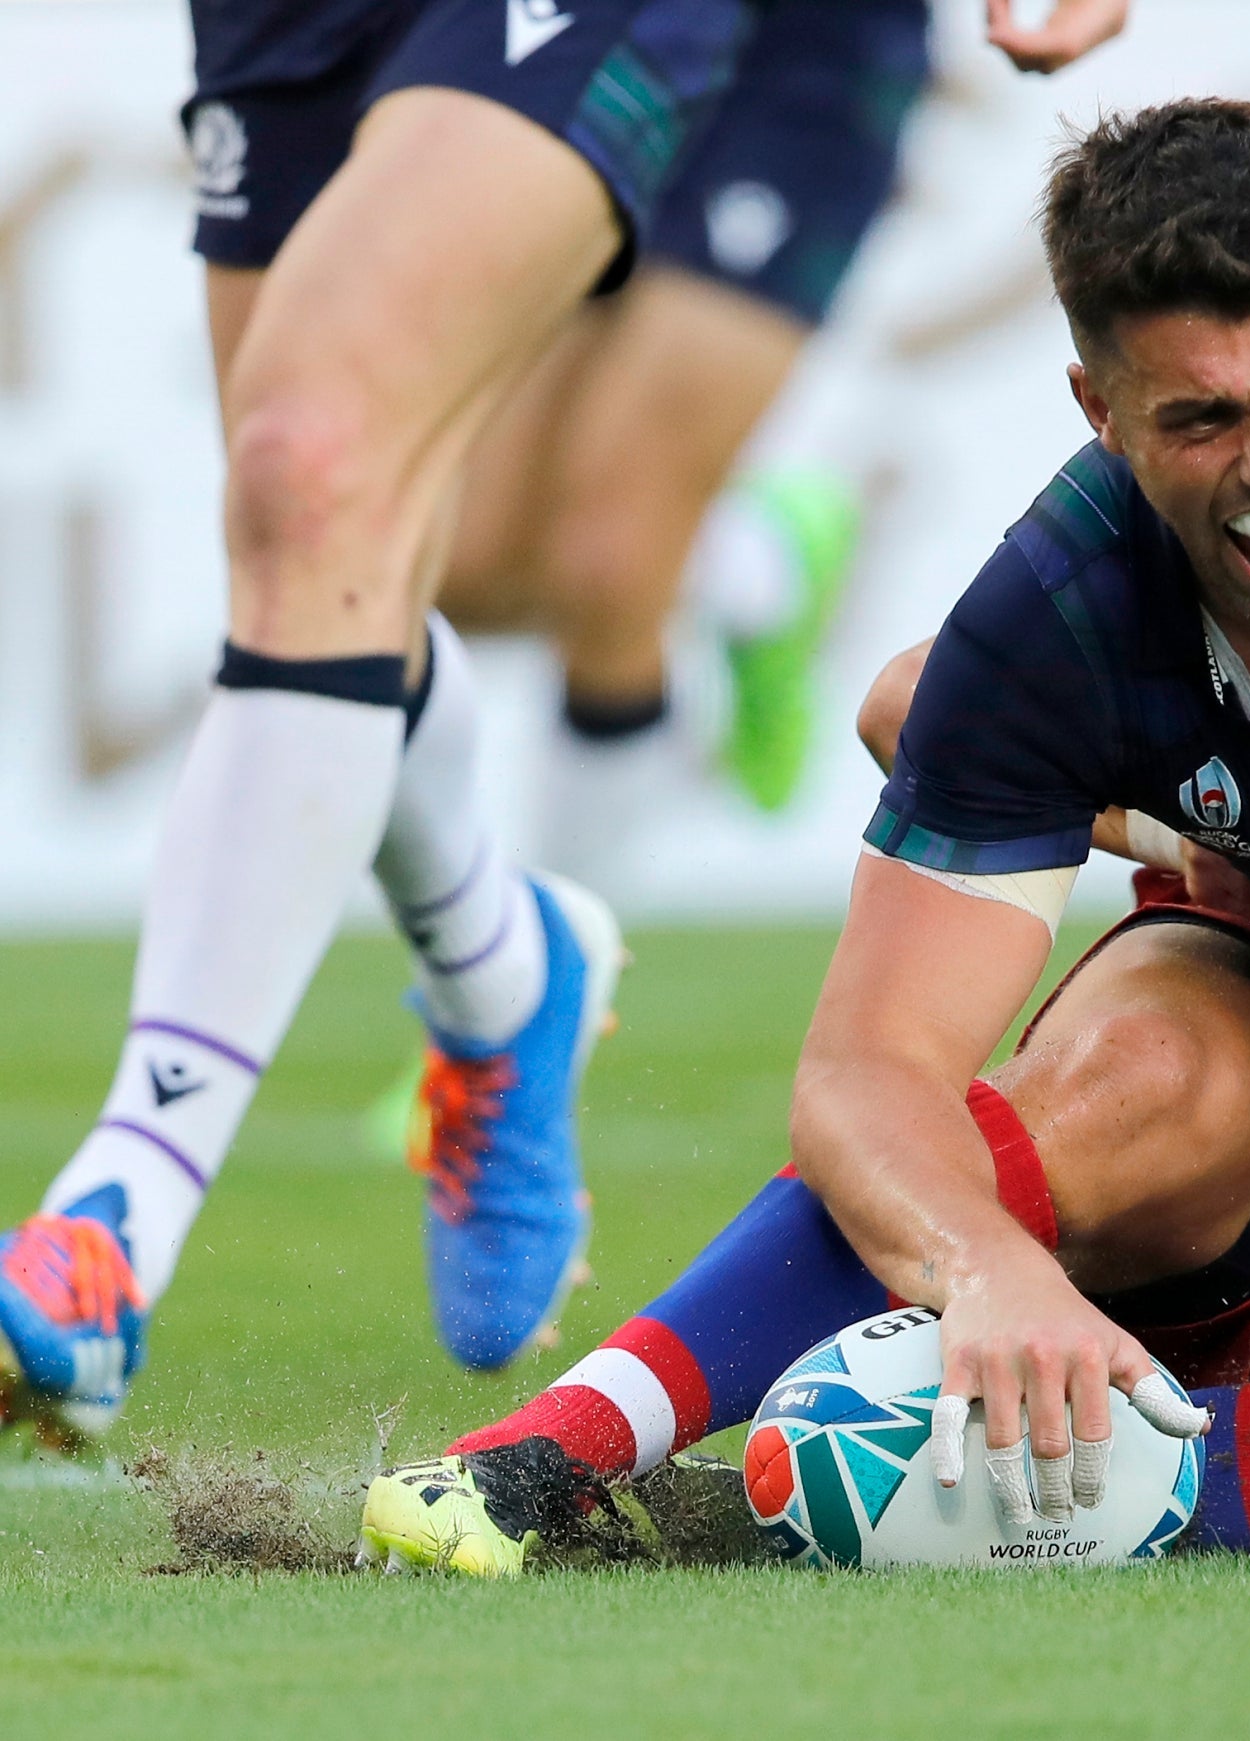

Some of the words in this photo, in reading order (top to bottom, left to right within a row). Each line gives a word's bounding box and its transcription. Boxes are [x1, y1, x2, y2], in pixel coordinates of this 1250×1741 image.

[805, 1388, 819, 1408] 2019
[1026, 1528, 1070, 1541] RUGBY
[989, 1543, 1060, 1559] WORLD
